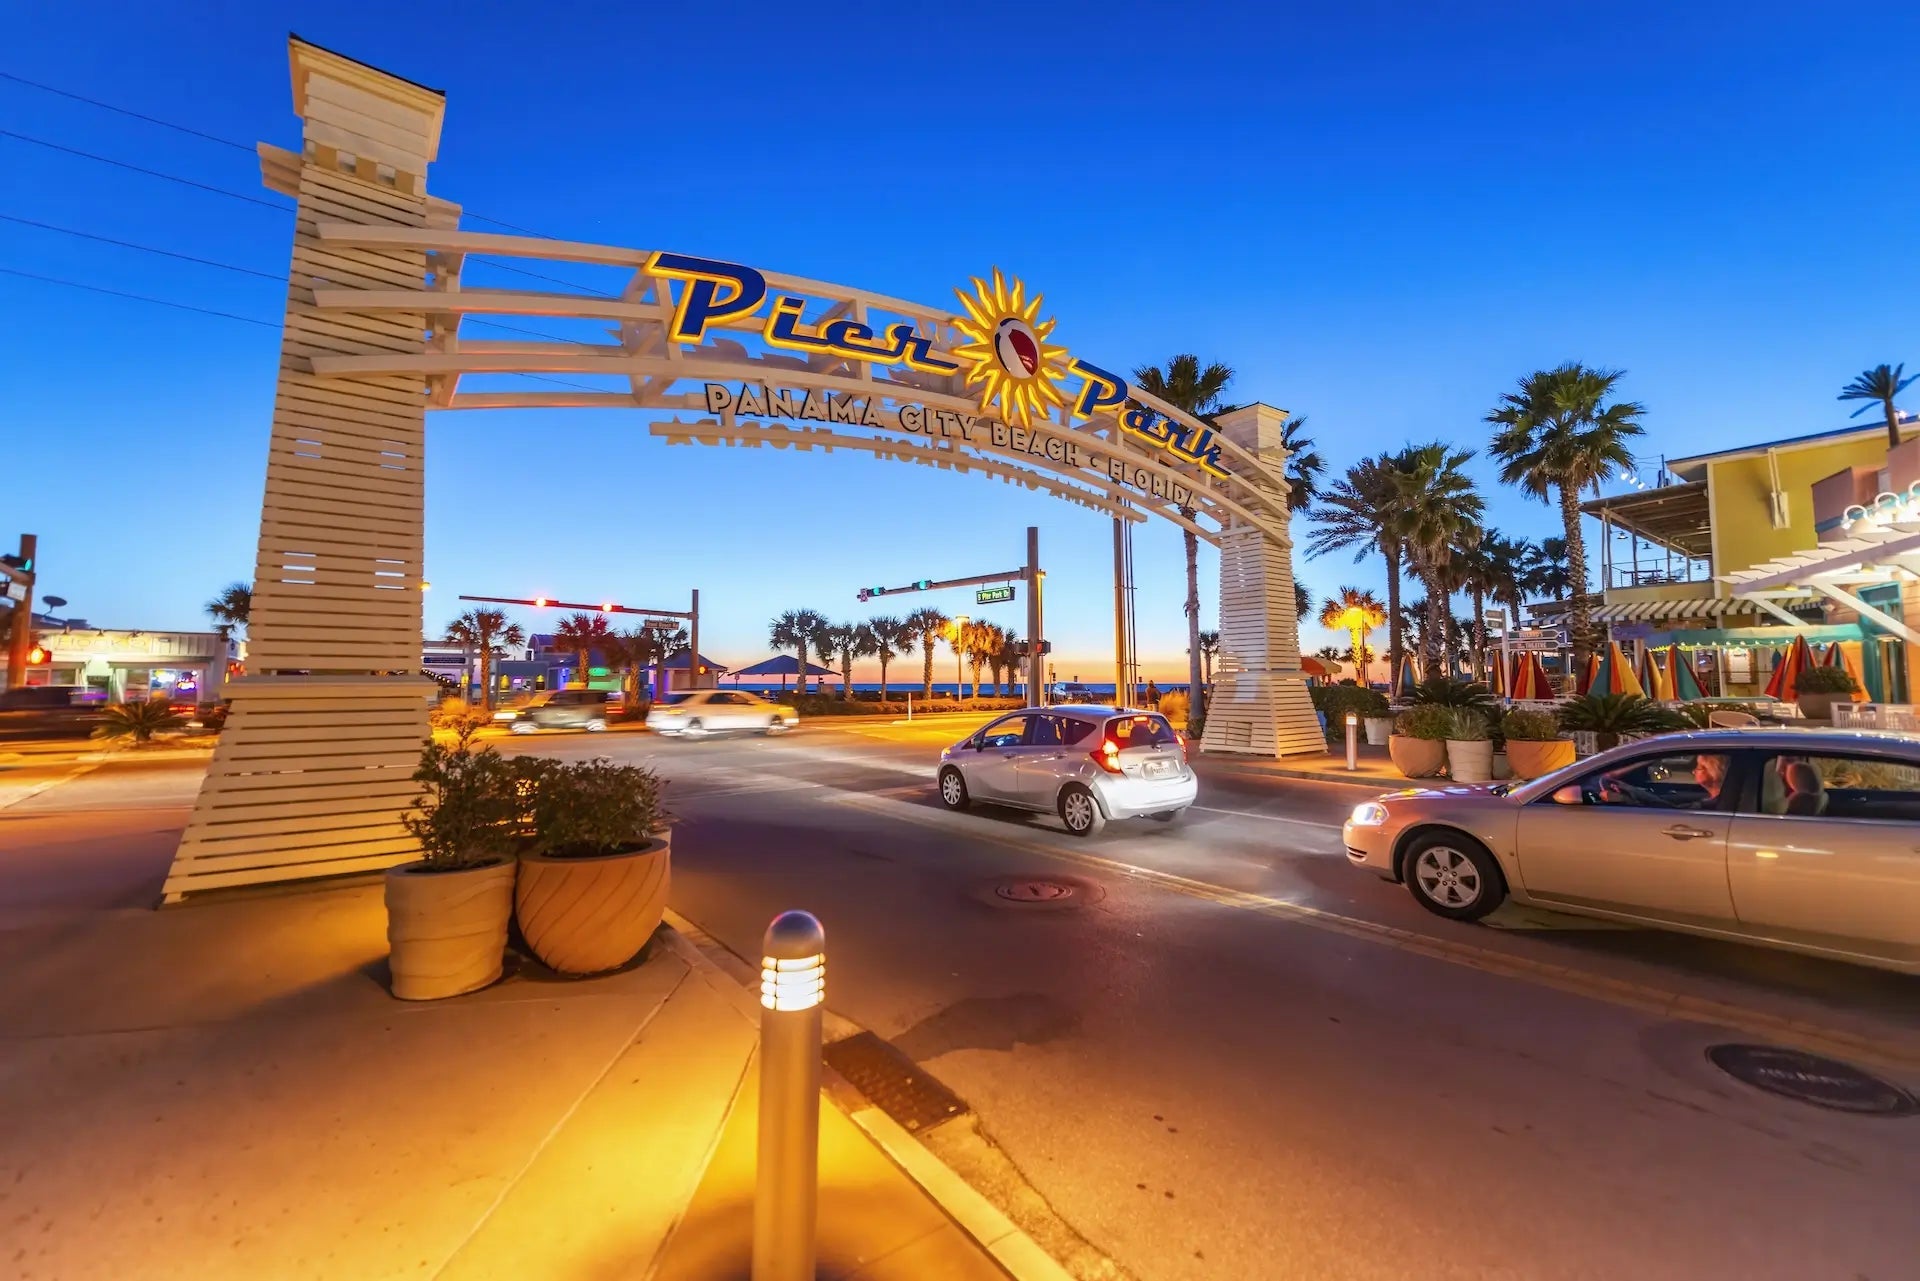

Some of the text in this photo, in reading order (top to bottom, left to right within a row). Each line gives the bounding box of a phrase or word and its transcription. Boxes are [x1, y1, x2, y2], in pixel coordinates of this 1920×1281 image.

[643, 251, 958, 376] Pier
[1068, 357, 1232, 480] Park
[704, 382, 885, 429] PANAMA
[899, 404, 978, 441] CITY
[990, 421, 1081, 468] BEACH
[1108, 457, 1198, 511] FLORIDA
[981, 592, 991, 601] Pier
[992, 591, 1003, 599] Park
